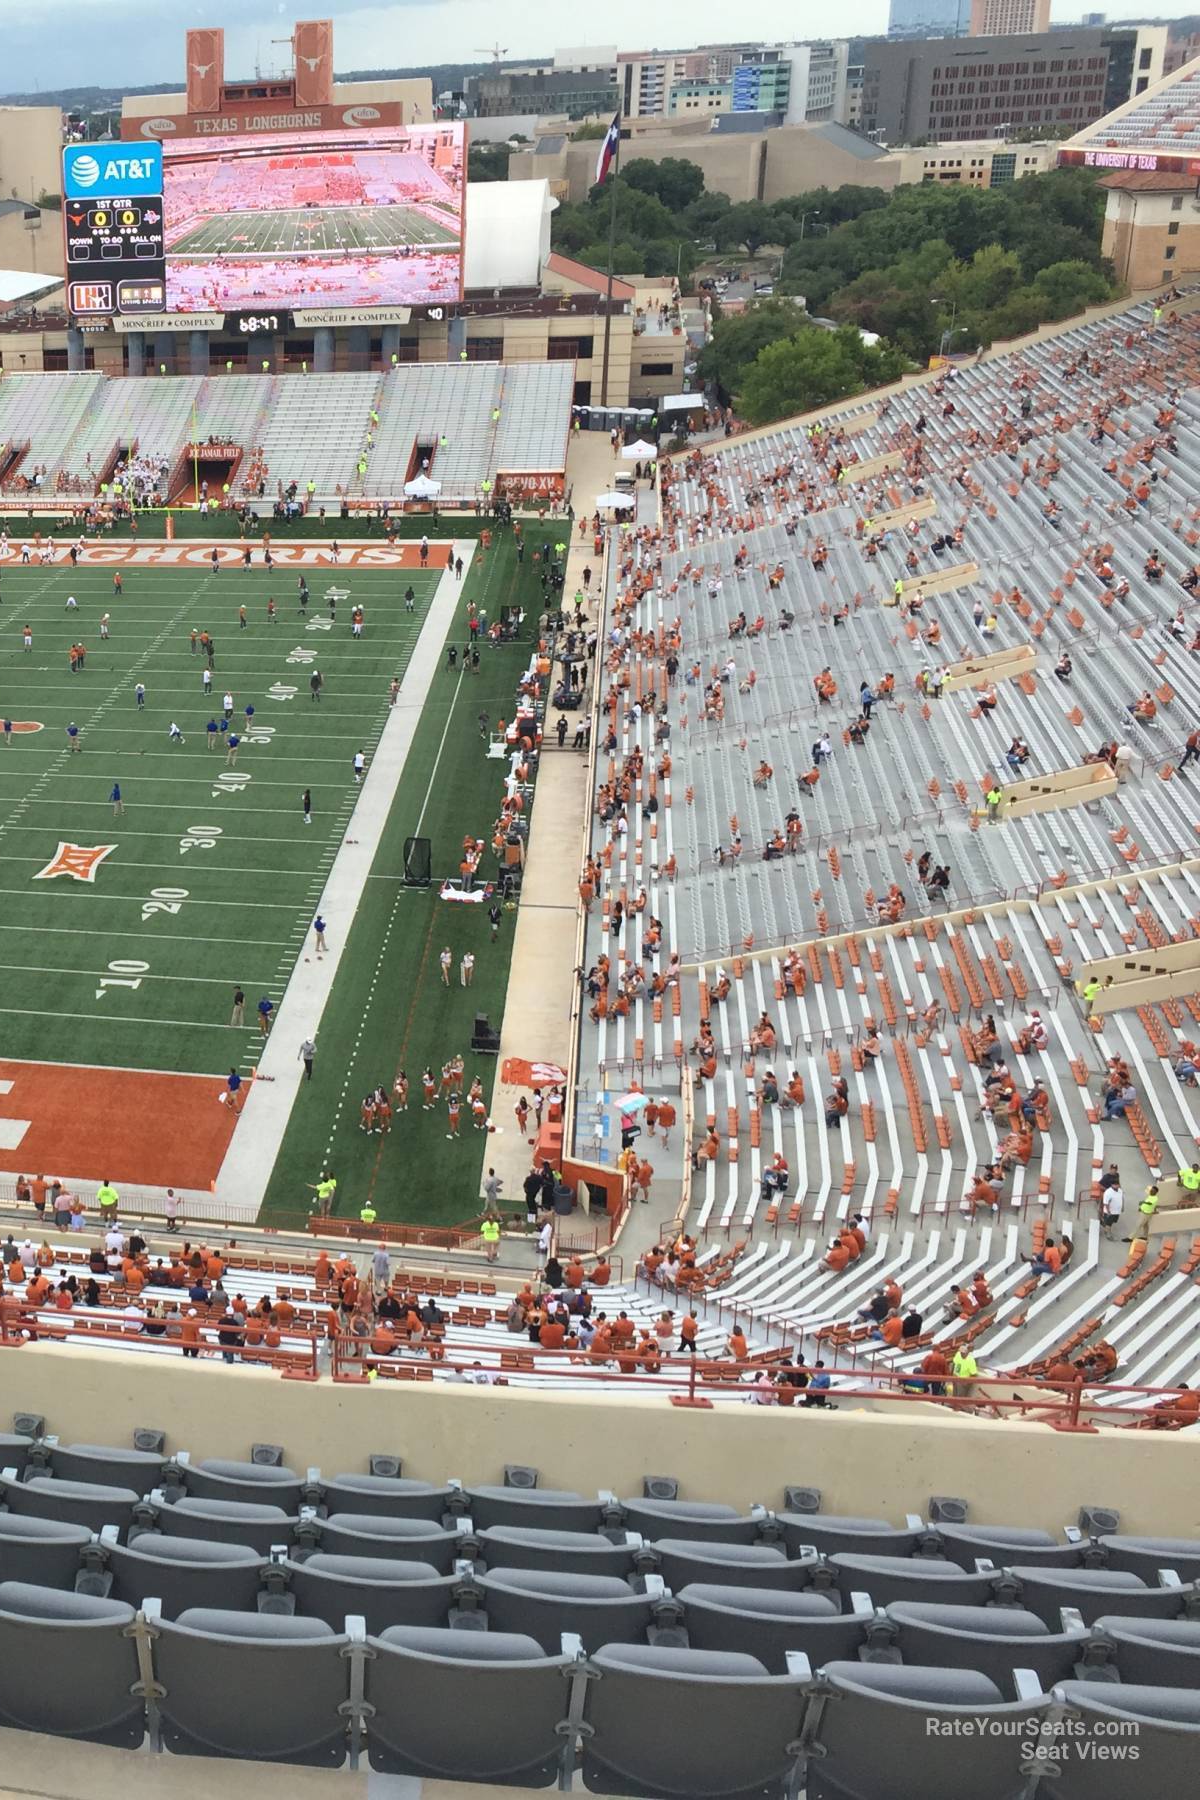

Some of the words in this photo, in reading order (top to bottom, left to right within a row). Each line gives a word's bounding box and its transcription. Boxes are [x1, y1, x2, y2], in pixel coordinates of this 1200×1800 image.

[194, 117, 239, 133] TEXAS
[244, 112, 322, 131] LONGHORNS
[1084, 152, 1095, 166] THE
[1095, 153, 1128, 168] UNIVERSITY
[1128, 154, 1137, 168] OF
[1137, 155, 1158, 170] TEXAS
[104, 158, 155, 180] AT&T
[96, 200, 111, 209] 1ST
[113, 199, 132, 208] QTR
[94, 212, 107, 226] 0
[122, 210, 135, 225] 0
[69, 238, 93, 246] DOWN
[111, 236, 123, 244] GO
[130, 235, 148, 243] BALL
[149, 234, 162, 242] ON
[303, 315, 348, 323] MONCRIEF
[358, 312, 401, 322] COMPLEX
[428, 308, 443, 320] 40
[122, 320, 164, 328] MONCRIEF
[174, 318, 216, 326] COMPLEX
[200, 449, 223, 458] JAMAIL
[223, 449, 241, 458] FIELD
[305, 617, 335, 630] 20
[285, 649, 318, 664] 30
[265, 685, 299, 701] 40
[240, 726, 277, 745] 50
[213, 772, 252, 793] 40
[179, 825, 224, 849] 30
[141, 887, 190, 914] 20
[99, 958, 150, 990] 10
